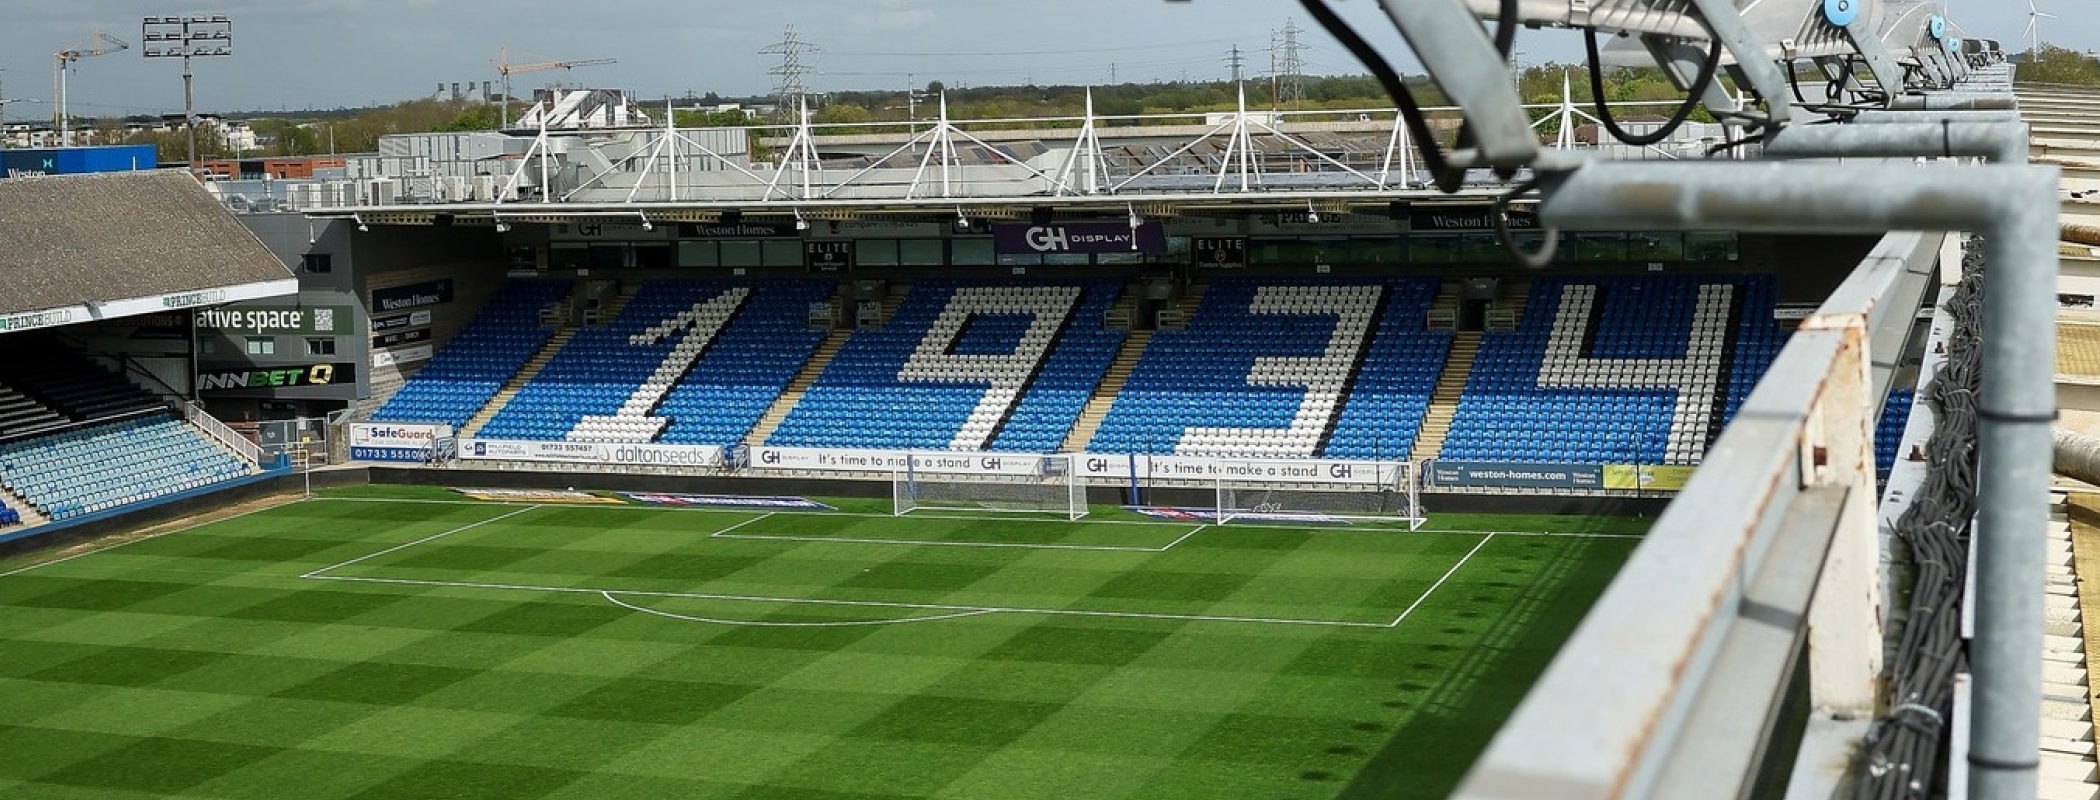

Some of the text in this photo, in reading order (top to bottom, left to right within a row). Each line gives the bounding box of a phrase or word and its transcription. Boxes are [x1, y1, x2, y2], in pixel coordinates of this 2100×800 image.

[1432, 214, 1531, 228] Weston Hmes
[696, 224, 776, 236] Weston Homes
[1025, 226, 1130, 252] GH DISPLAY
[1198, 239, 1243, 251] ELITE
[809, 242, 850, 254] ELITE
[382, 293, 441, 311] Weston Homes
[7, 310, 72, 330] PRINCEBUILD
[246, 309, 302, 335] space
[371, 426, 433, 440] SafeGuard
[355, 449, 388, 459] 01733
[541, 443, 563, 451] 01733
[615, 445, 705, 464] daltonseeds
[761, 450, 781, 465] GH
[819, 453, 970, 468] It's time to mae a stand
[981, 458, 1001, 471] GH
[1086, 458, 1108, 472] GH
[1175, 462, 1203, 474] time
[1226, 462, 1263, 476] make
[1267, 466, 1276, 476] a
[1280, 464, 1318, 478] stand
[1330, 464, 1352, 479] GH
[1469, 469, 1567, 480] weston-homes.com
